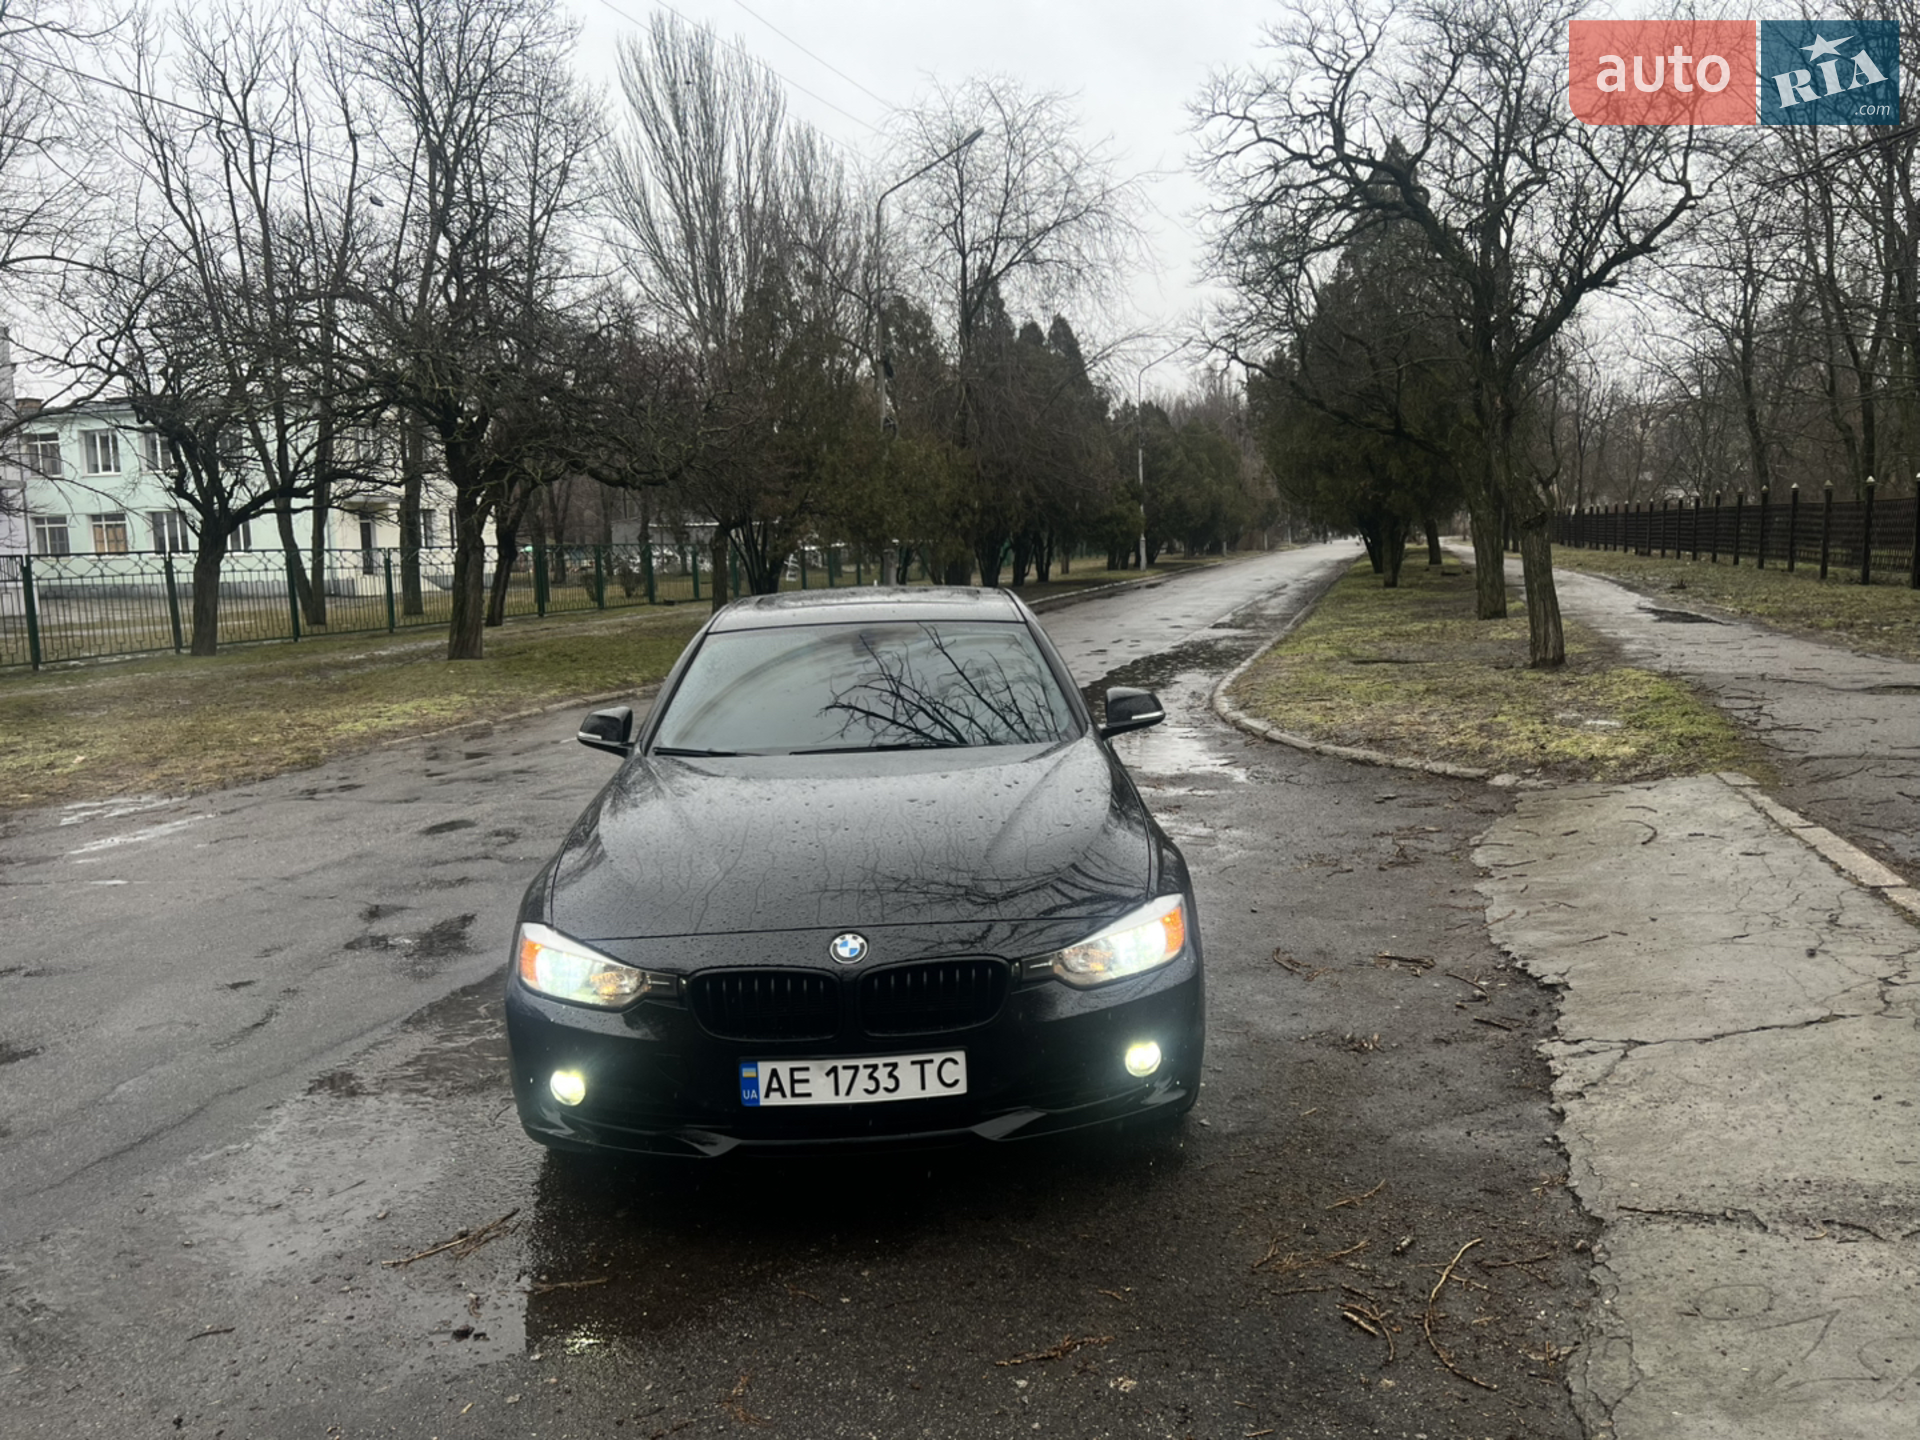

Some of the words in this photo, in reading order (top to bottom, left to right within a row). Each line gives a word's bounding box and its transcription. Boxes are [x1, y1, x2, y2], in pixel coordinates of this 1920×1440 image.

[764, 1066, 813, 1099] AE
[824, 1061, 901, 1097] 1733
[910, 1057, 961, 1091] TC
[742, 1089, 758, 1100] UA
